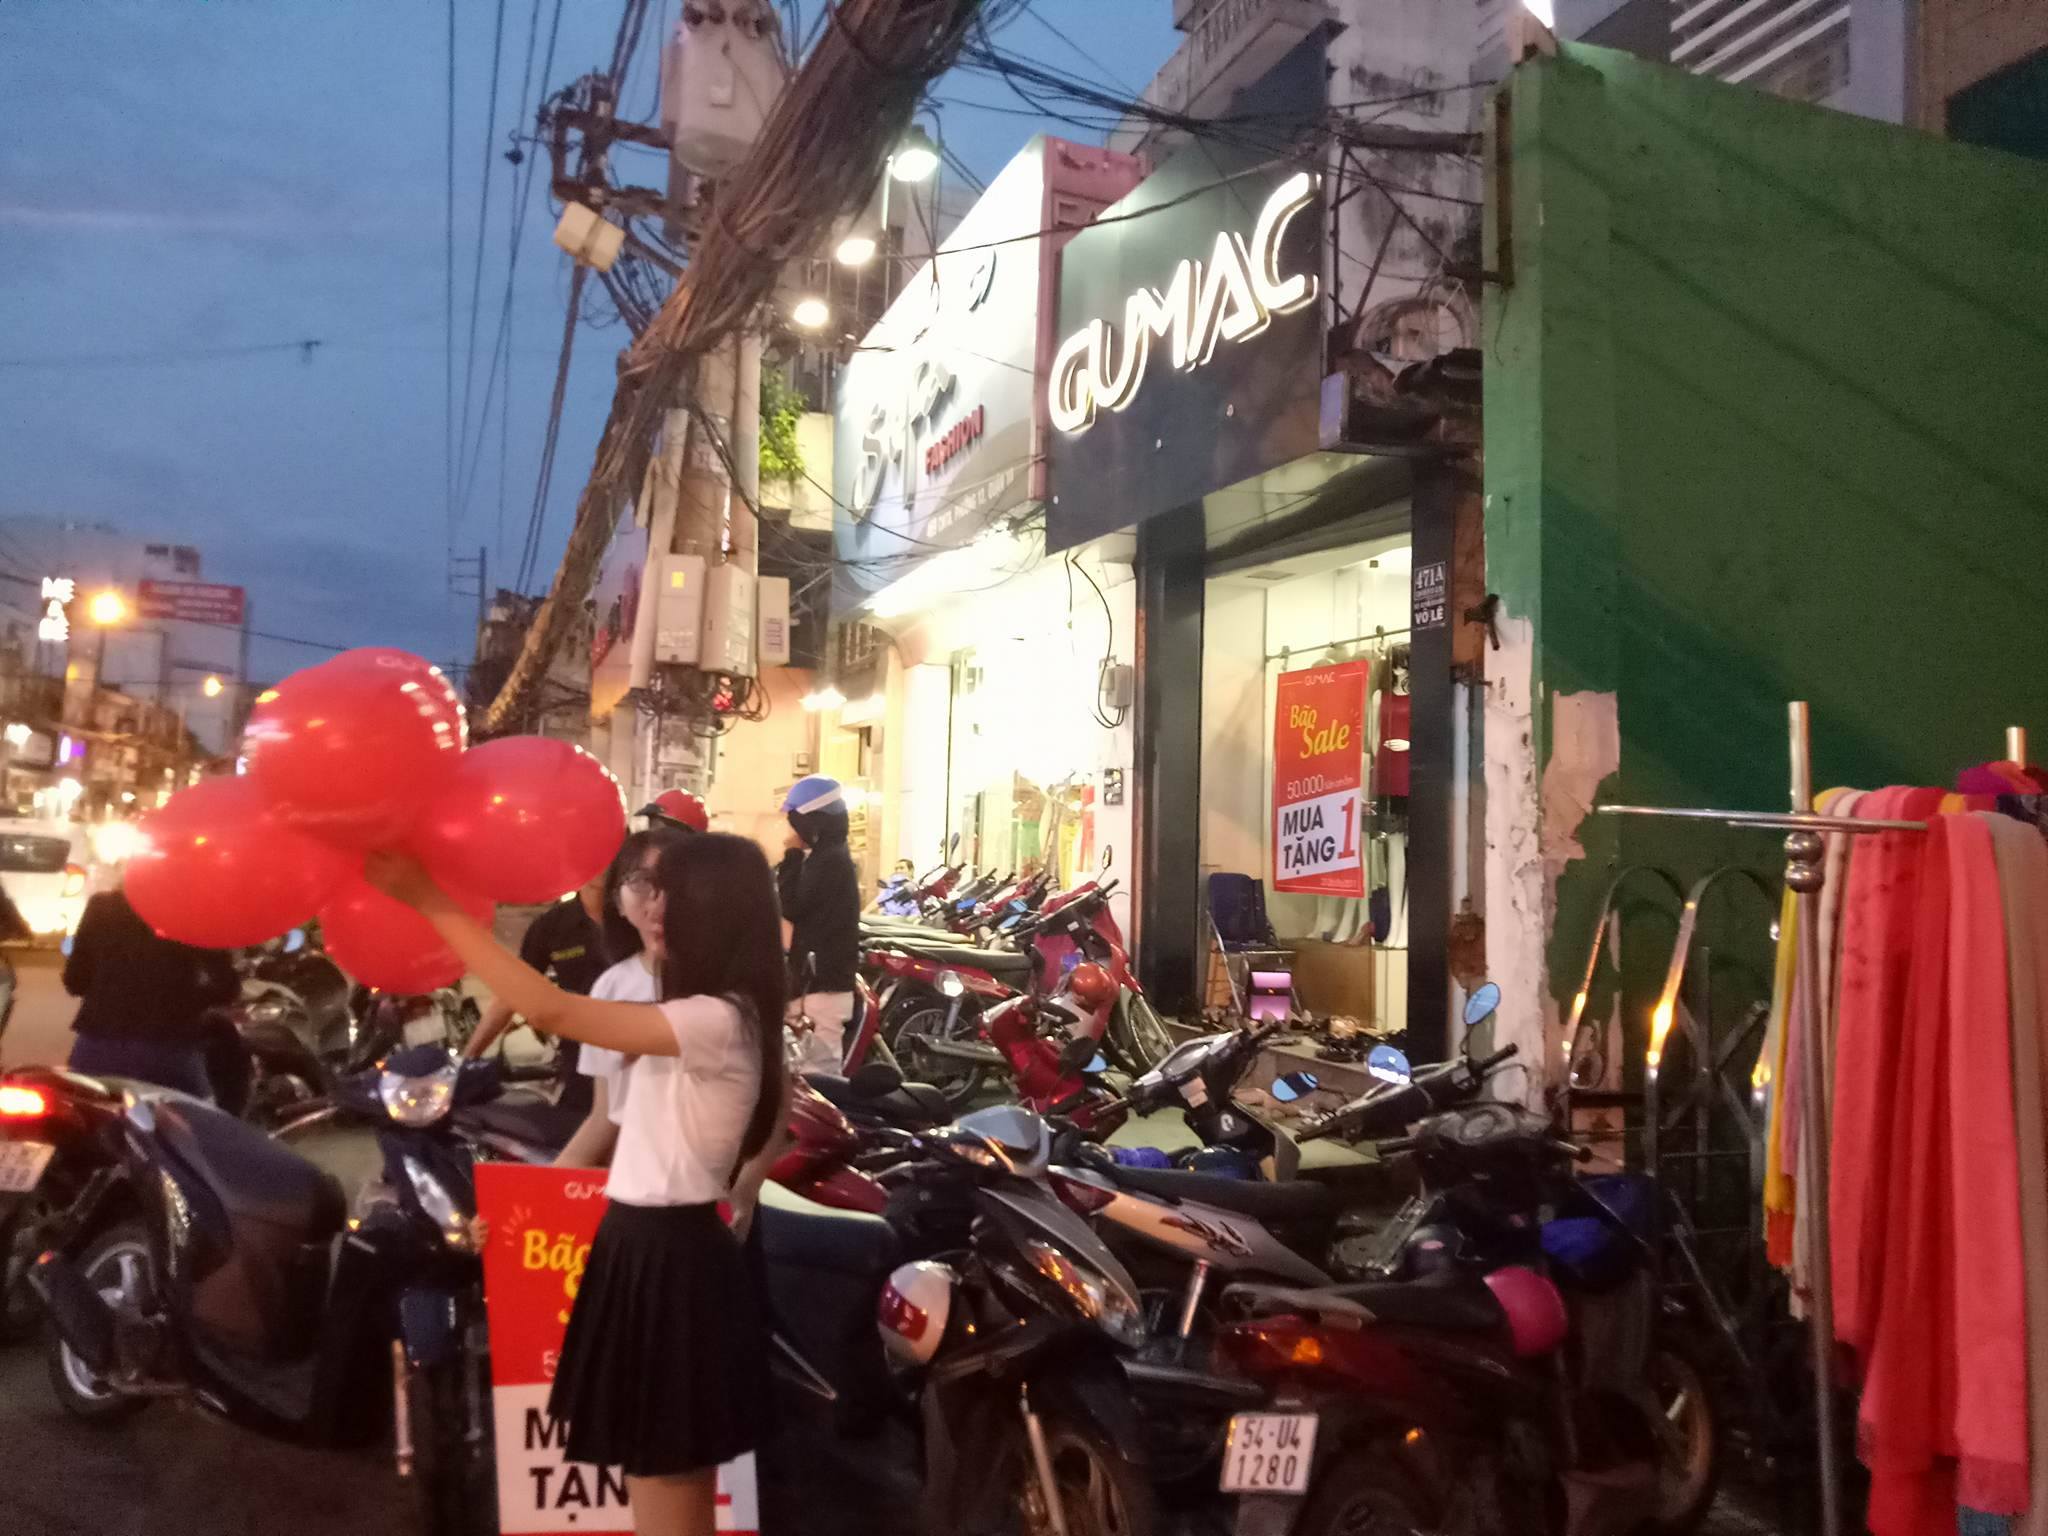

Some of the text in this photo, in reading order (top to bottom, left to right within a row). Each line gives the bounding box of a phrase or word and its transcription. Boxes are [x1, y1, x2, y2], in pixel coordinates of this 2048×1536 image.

[1049, 172, 1320, 434] GUMAC
[926, 404, 984, 476] FASHION
[1415, 565, 1444, 589] 471A
[1430, 604, 1444, 621] LÊ
[1290, 704, 1317, 729] Bão
[1300, 719, 1350, 759] Sale
[1287, 774, 1324, 800] 50.000
[1283, 805, 1324, 837] MUA
[1337, 796, 1356, 859] 1
[1283, 835, 1335, 875] TẶNG
[1237, 1454, 1297, 1486] 1280
